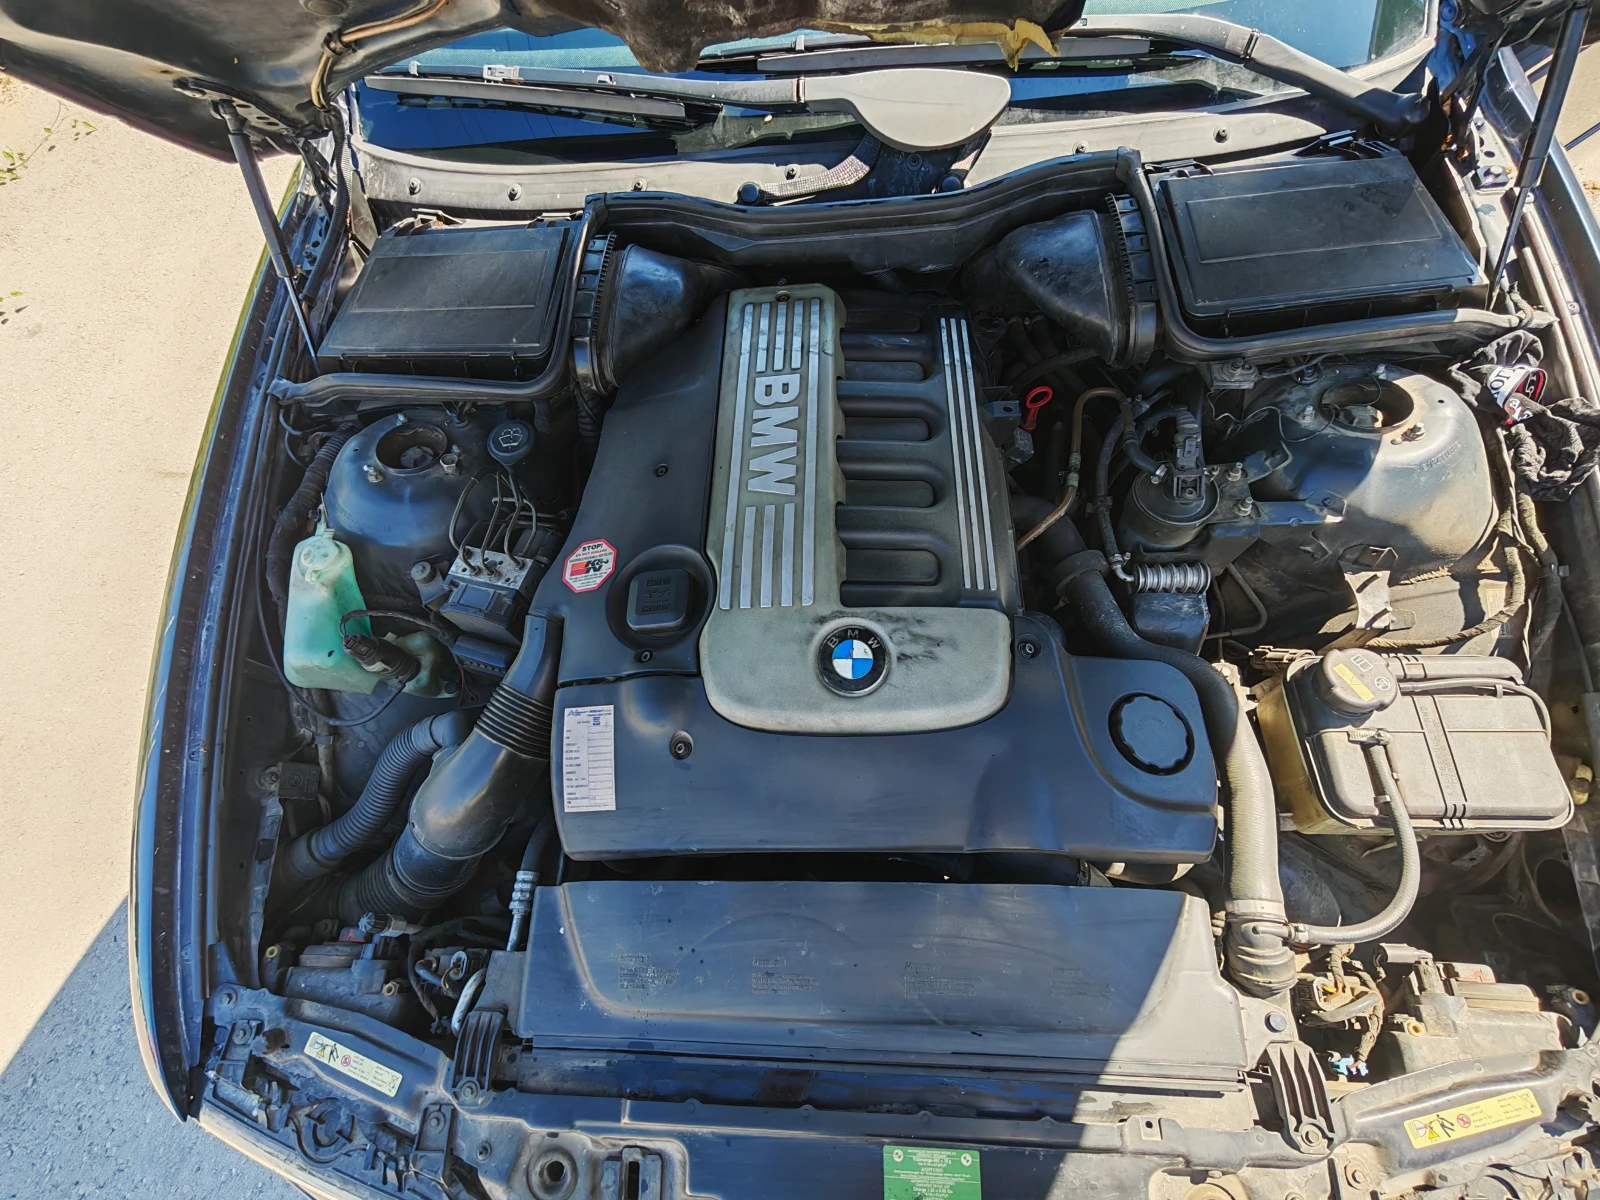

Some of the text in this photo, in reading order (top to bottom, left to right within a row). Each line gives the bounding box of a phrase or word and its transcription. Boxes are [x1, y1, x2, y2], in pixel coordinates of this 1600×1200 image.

[747, 373, 801, 496] BMW
[582, 543, 604, 552] STOP!
[646, 578, 671, 587] BMW
[641, 603, 669, 613] Castrol
[827, 629, 881, 649] BMW
